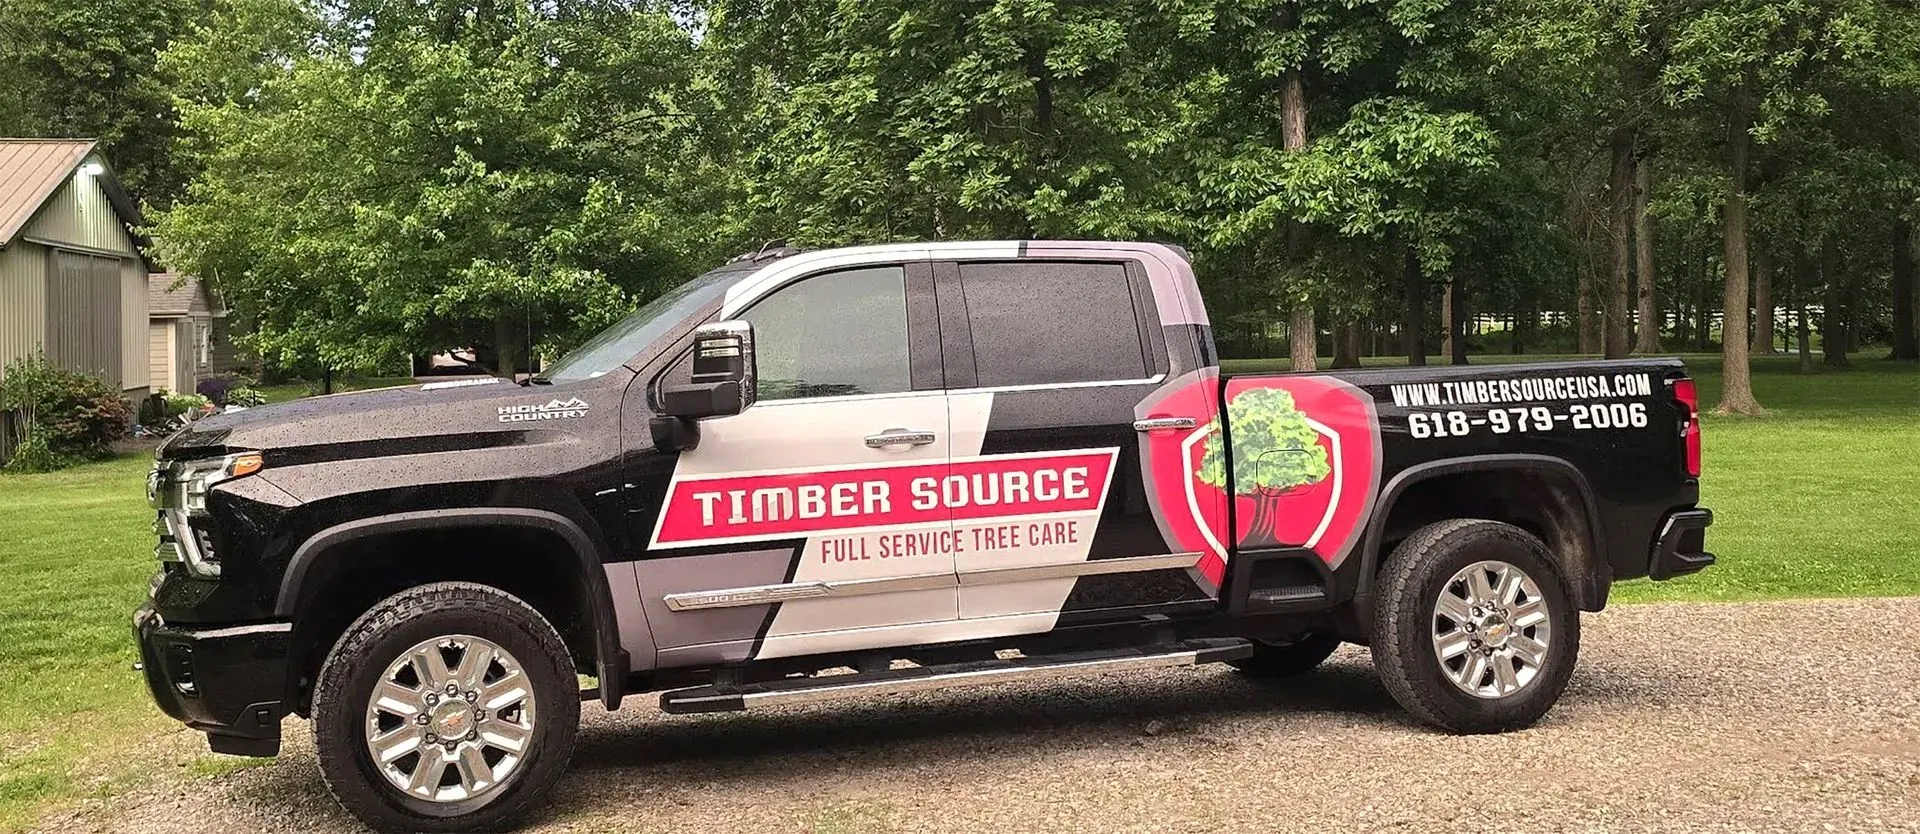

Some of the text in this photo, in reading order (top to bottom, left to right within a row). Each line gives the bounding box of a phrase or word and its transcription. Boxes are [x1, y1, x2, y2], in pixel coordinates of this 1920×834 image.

[454, 377, 500, 388] DURAMAX
[1390, 373, 1651, 407] WWW.TIMBERSOURCEUSA.COM
[498, 405, 545, 415] HIGH
[498, 409, 589, 423] COUNTRY
[1407, 402, 1648, 439] 618-979-2006
[692, 466, 1090, 527] TIMBER SOURCE
[820, 520, 1078, 564] FULL SERVICE TREE CARE
